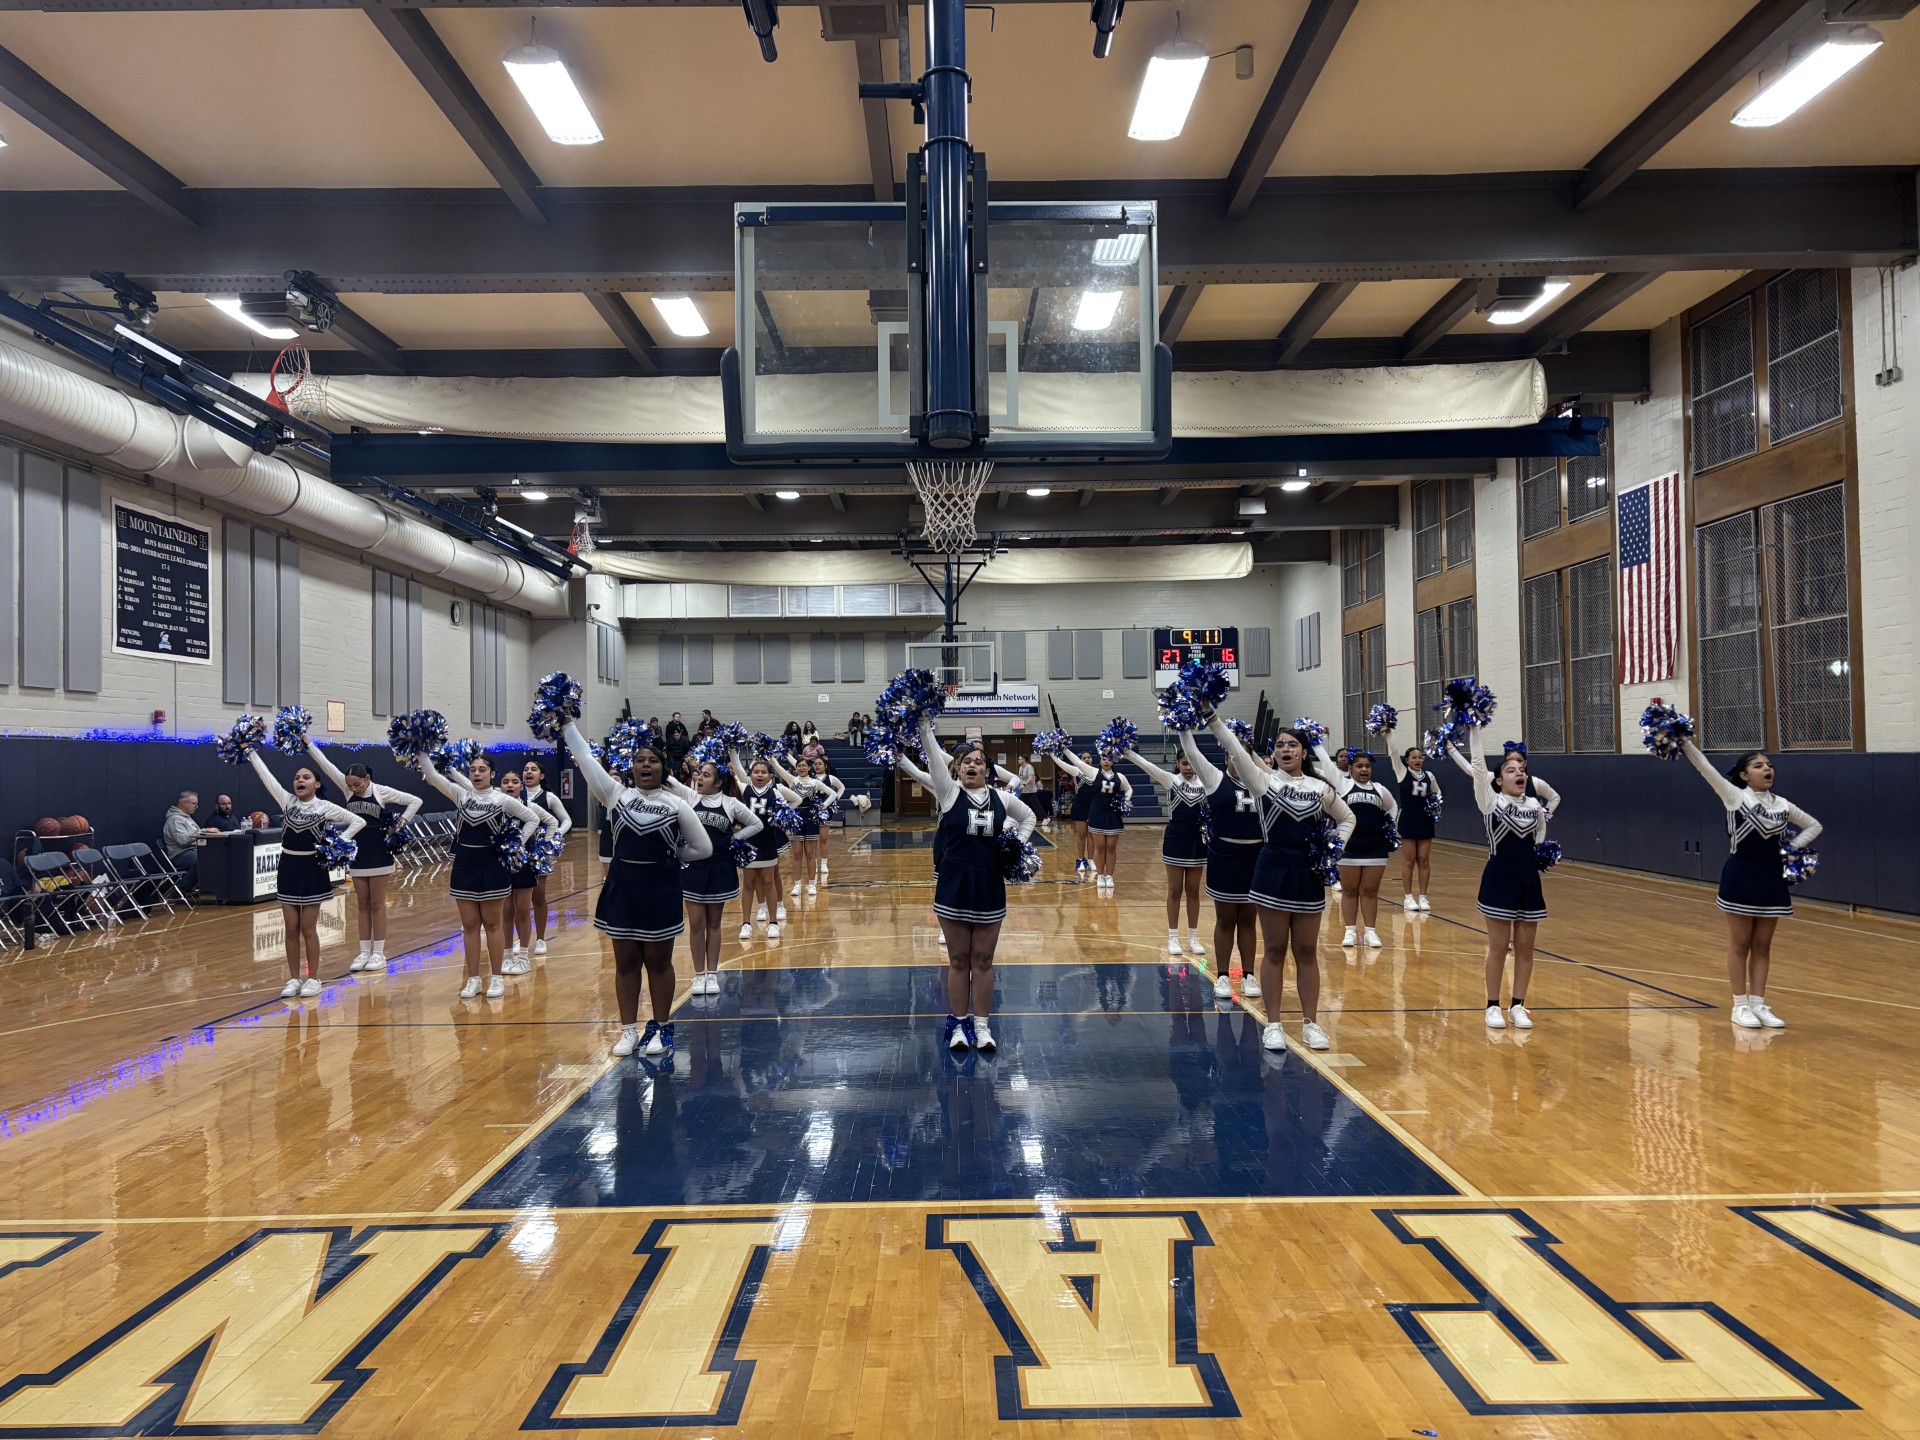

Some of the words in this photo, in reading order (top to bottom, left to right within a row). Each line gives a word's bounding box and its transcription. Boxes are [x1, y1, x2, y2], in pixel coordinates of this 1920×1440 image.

[130, 516, 198, 546] MOUNTAINEERS
[144, 538, 156, 546] BOYS
[158, 542, 185, 554] BASKETBALL
[1162, 650, 1180, 663] 27
[1222, 649, 1234, 662] 16
[1101, 780, 1115, 793] H
[1412, 781, 1428, 797] H
[621, 798, 670, 816] Mounts
[750, 797, 768, 815] H
[967, 808, 994, 836] H
[256, 854, 279, 874] HAZLE
